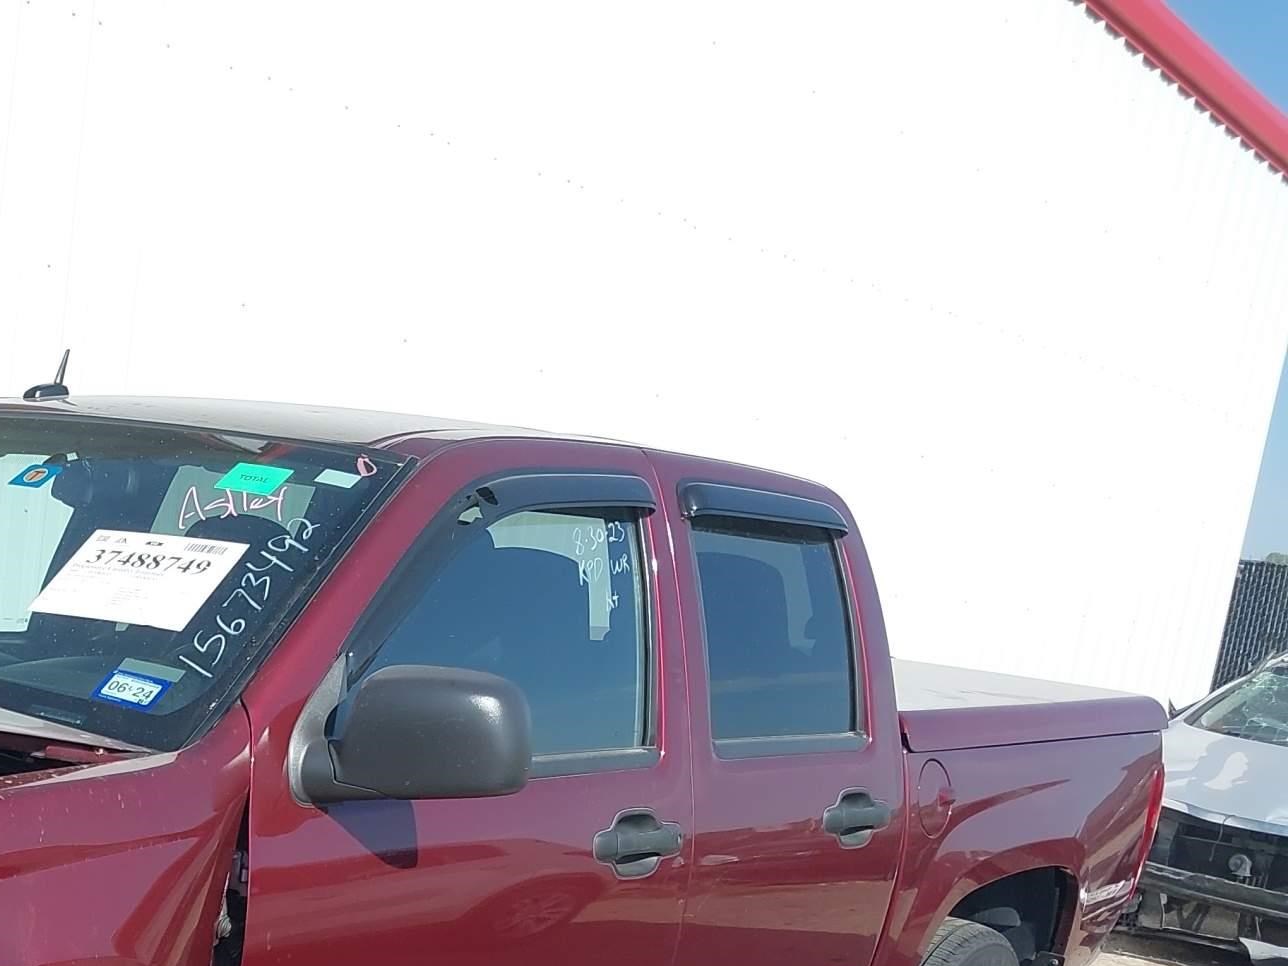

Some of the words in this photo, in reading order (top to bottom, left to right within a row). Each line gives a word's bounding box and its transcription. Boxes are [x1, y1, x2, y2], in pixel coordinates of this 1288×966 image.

[239, 473, 270, 483] TOTAL
[85, 549, 212, 575] 37488749
[179, 518, 321, 678] 15673492
